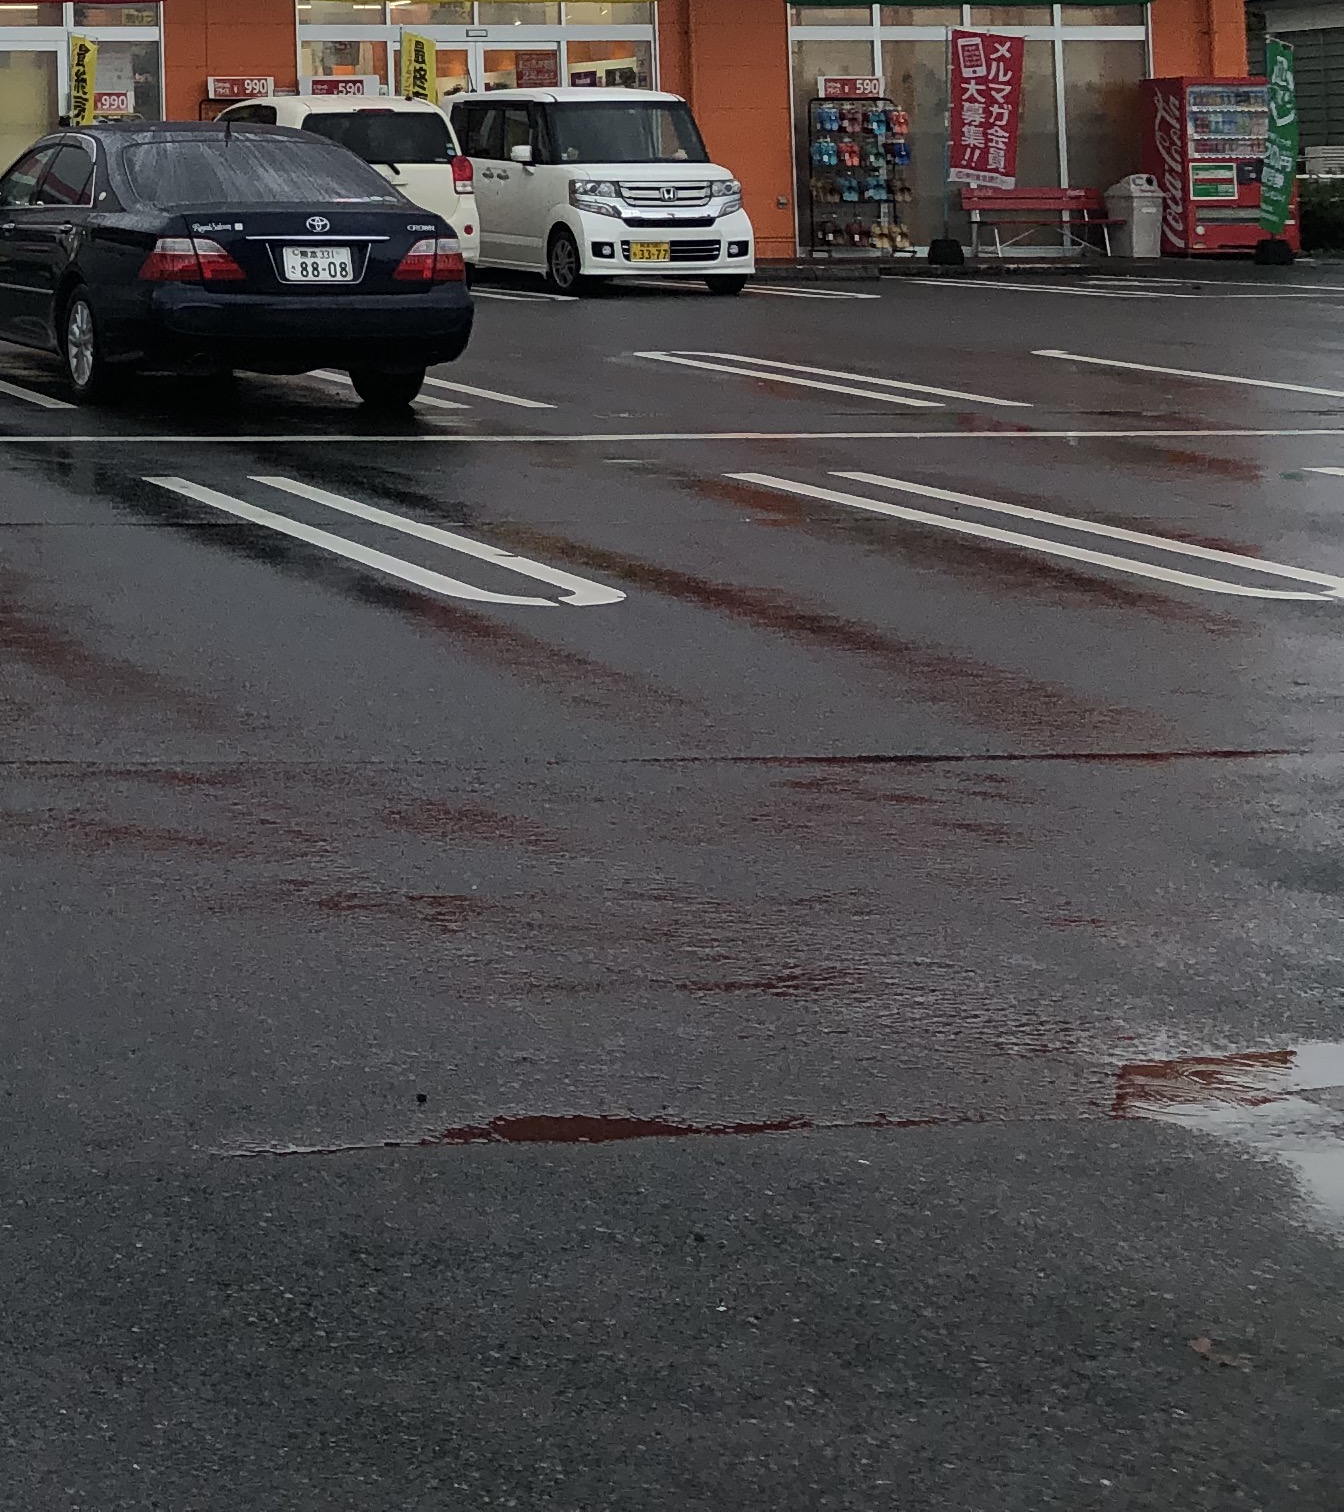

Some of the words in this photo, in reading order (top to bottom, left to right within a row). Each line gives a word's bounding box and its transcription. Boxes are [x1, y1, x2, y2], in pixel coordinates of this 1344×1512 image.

[855, 79, 879, 94] 590
[987, 41, 1013, 172] メルマガ会員
[300, 261, 349, 278] 88-08
